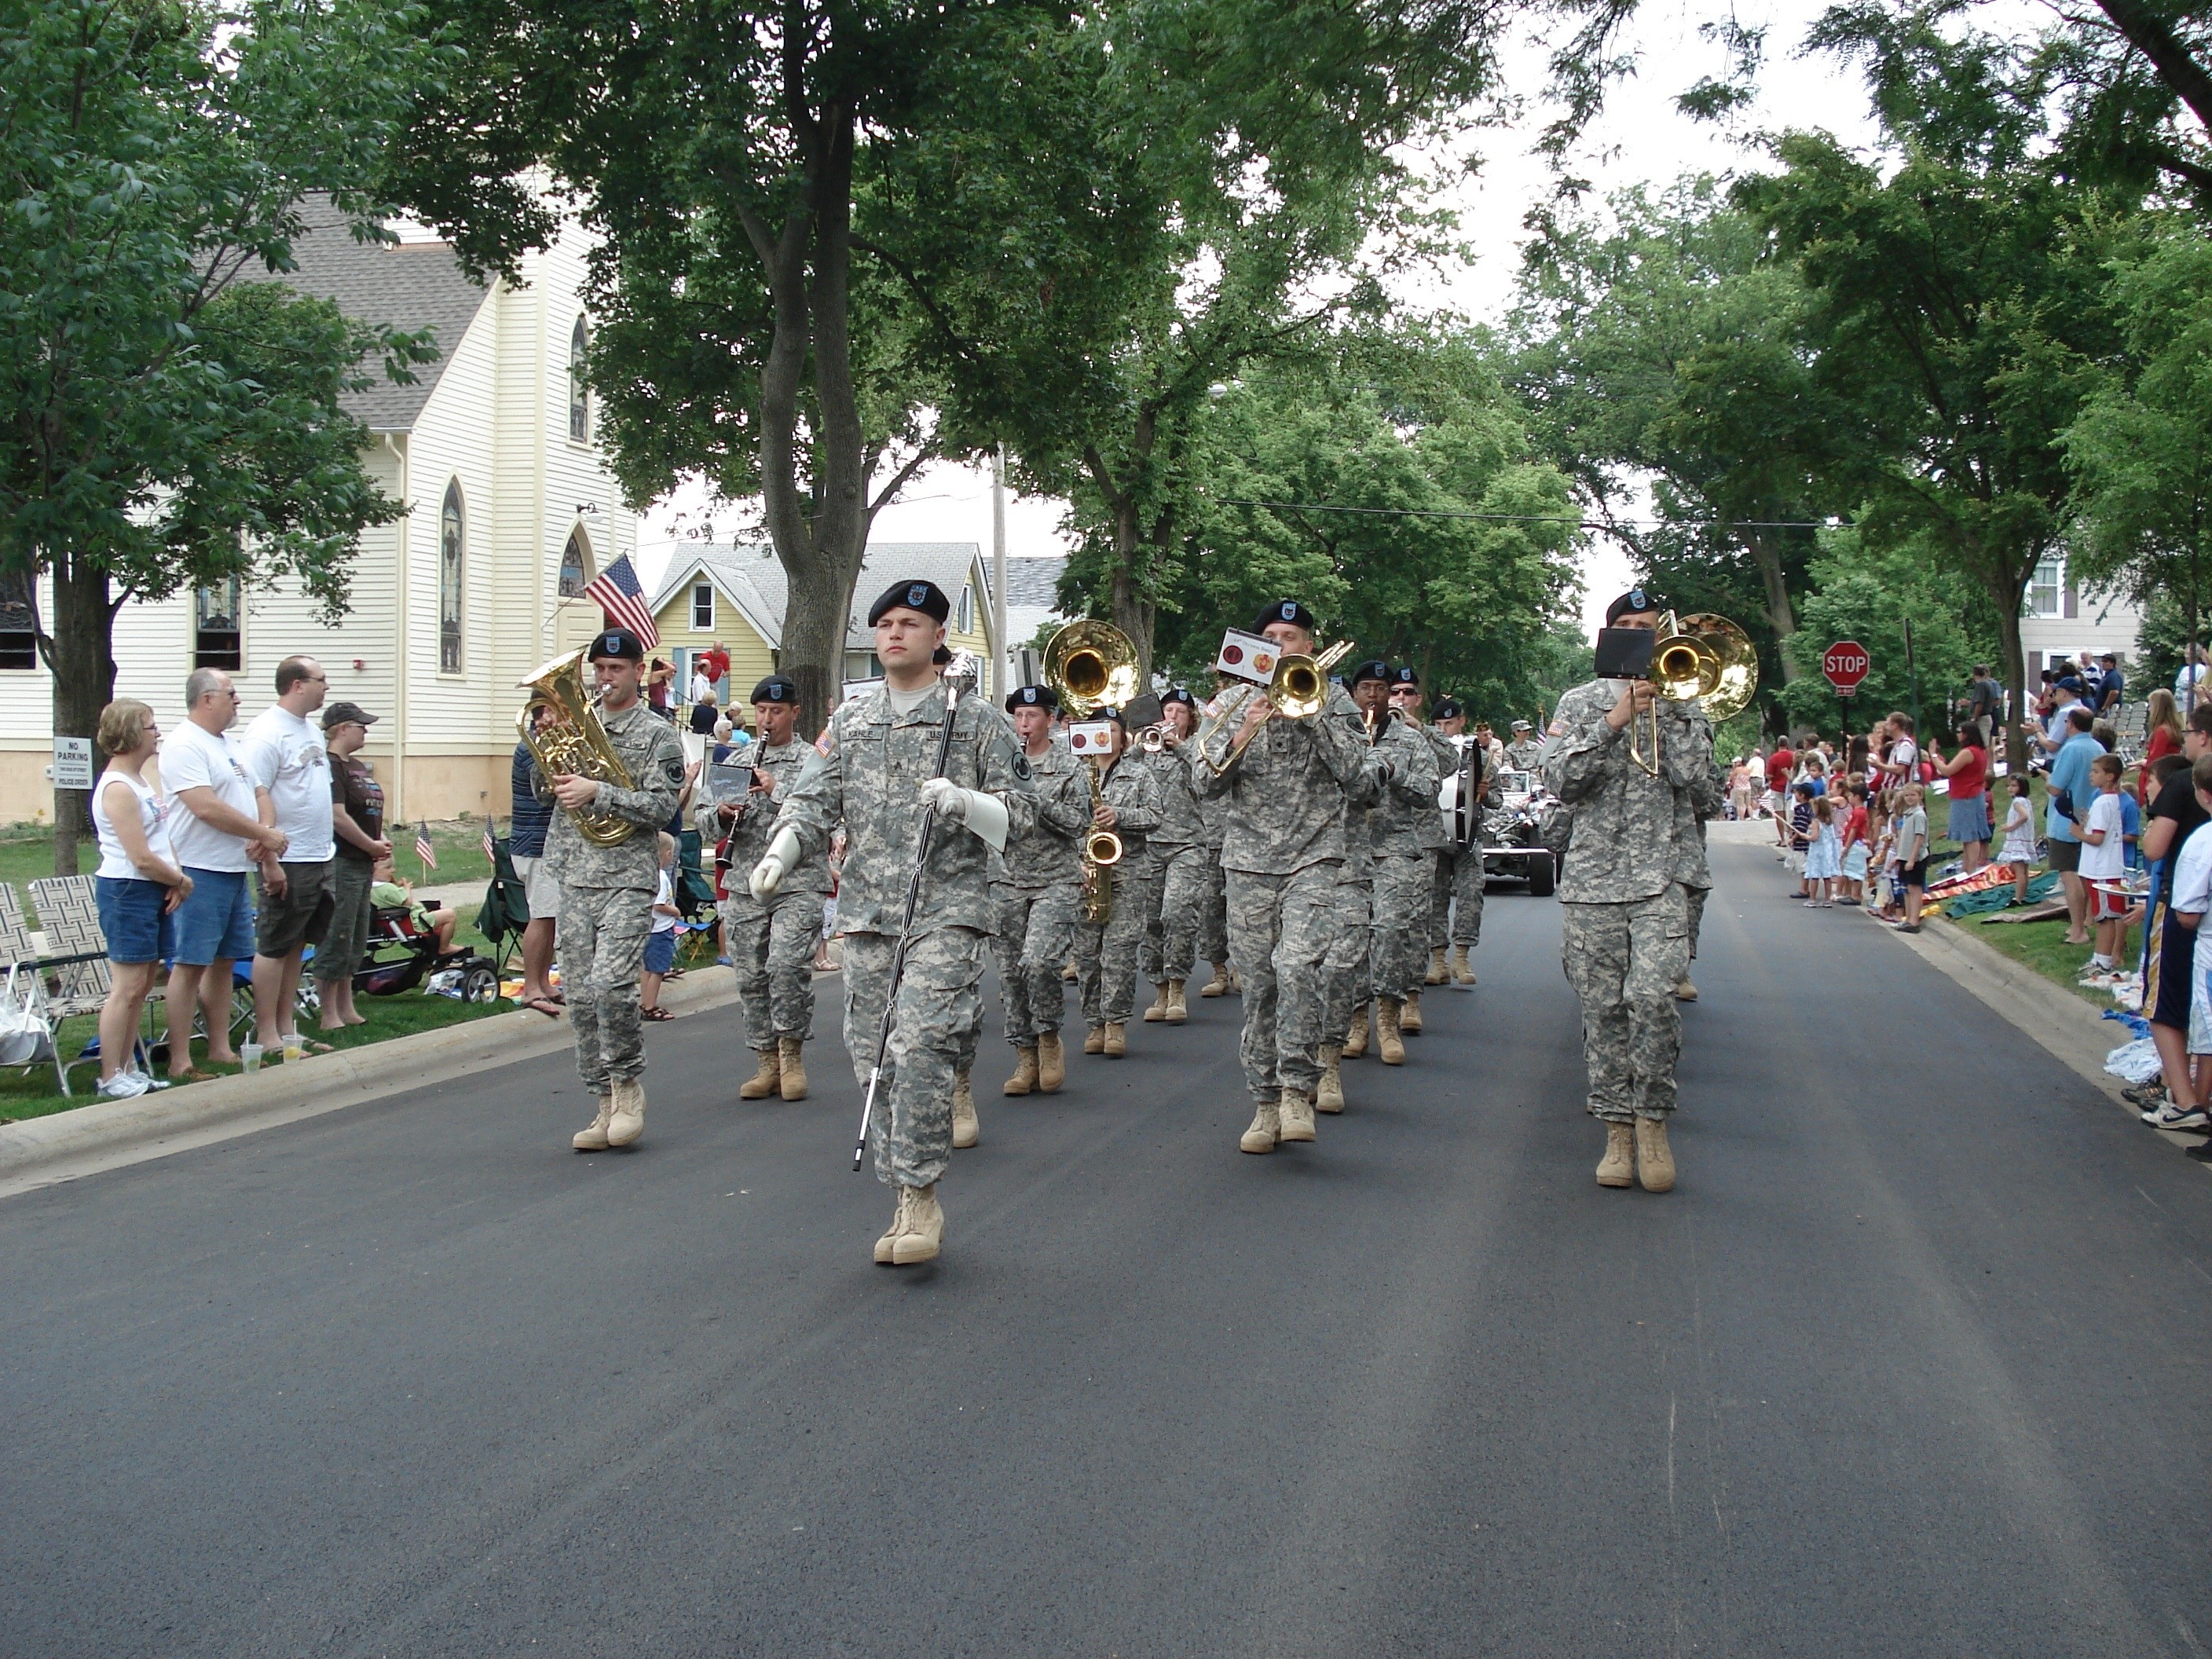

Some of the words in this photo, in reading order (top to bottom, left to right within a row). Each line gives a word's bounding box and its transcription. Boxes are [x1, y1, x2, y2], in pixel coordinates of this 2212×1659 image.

[1826, 655, 1866, 672] STOP
[68, 742, 79, 750] NO
[57, 752, 88, 761] PARKING
